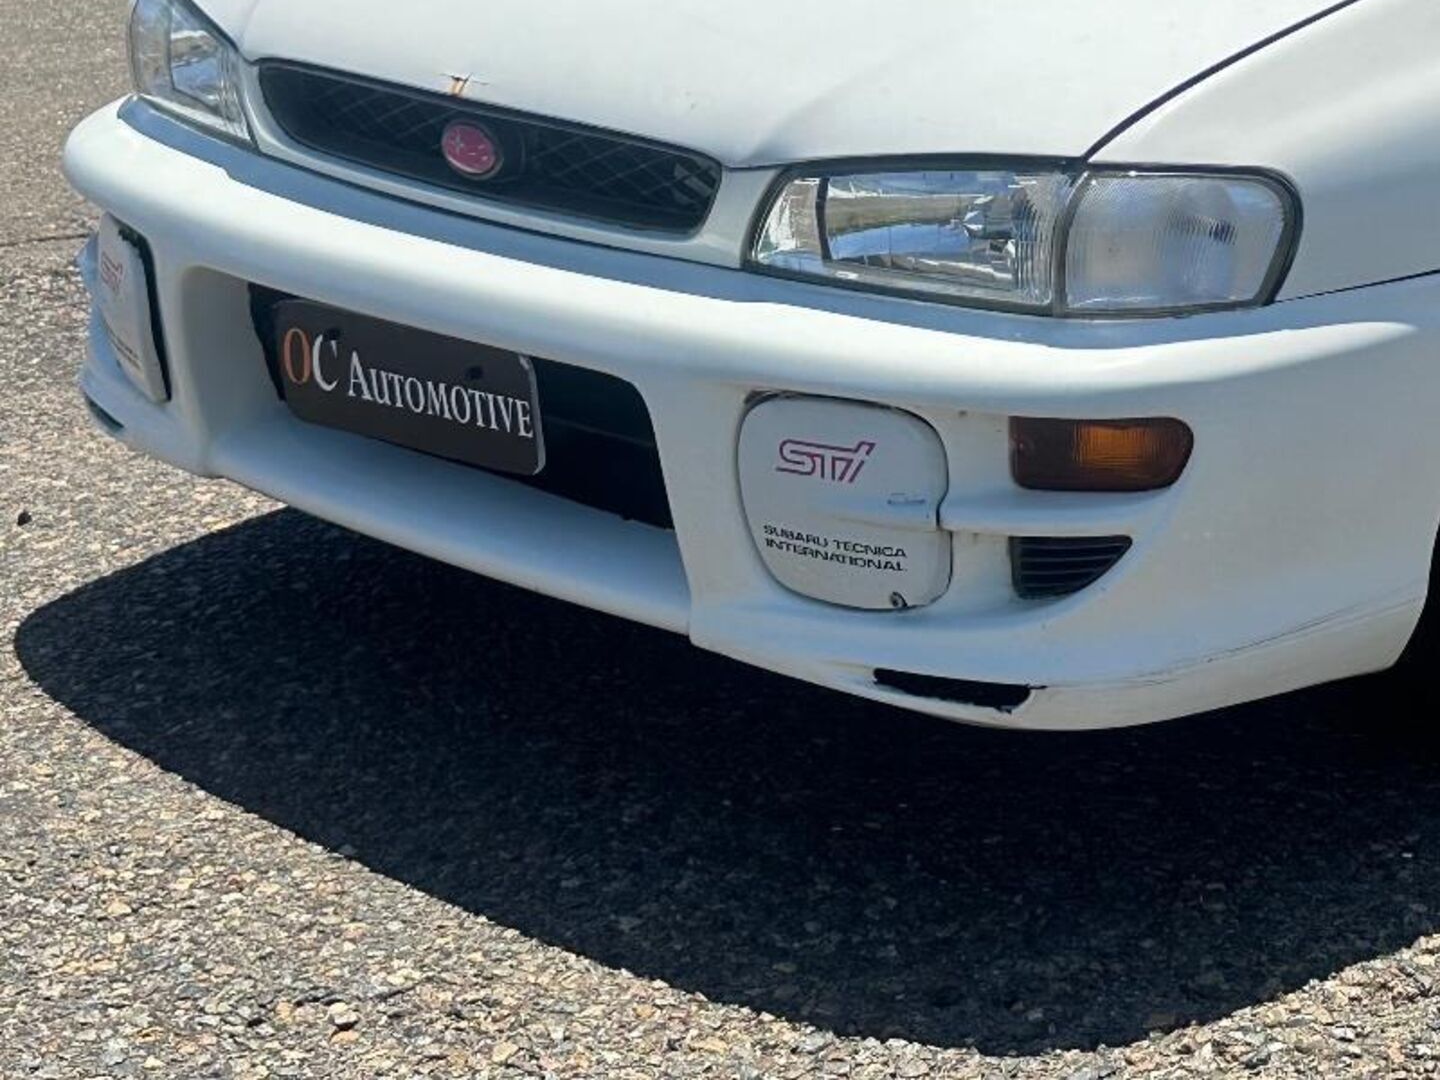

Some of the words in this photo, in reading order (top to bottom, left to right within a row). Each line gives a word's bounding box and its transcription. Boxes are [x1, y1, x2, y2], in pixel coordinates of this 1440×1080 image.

[283, 327, 339, 391] OC
[764, 525, 828, 547] SUBARU
[833, 539, 908, 558] TECNICA
[764, 538, 906, 571] INTERNATIONAL
